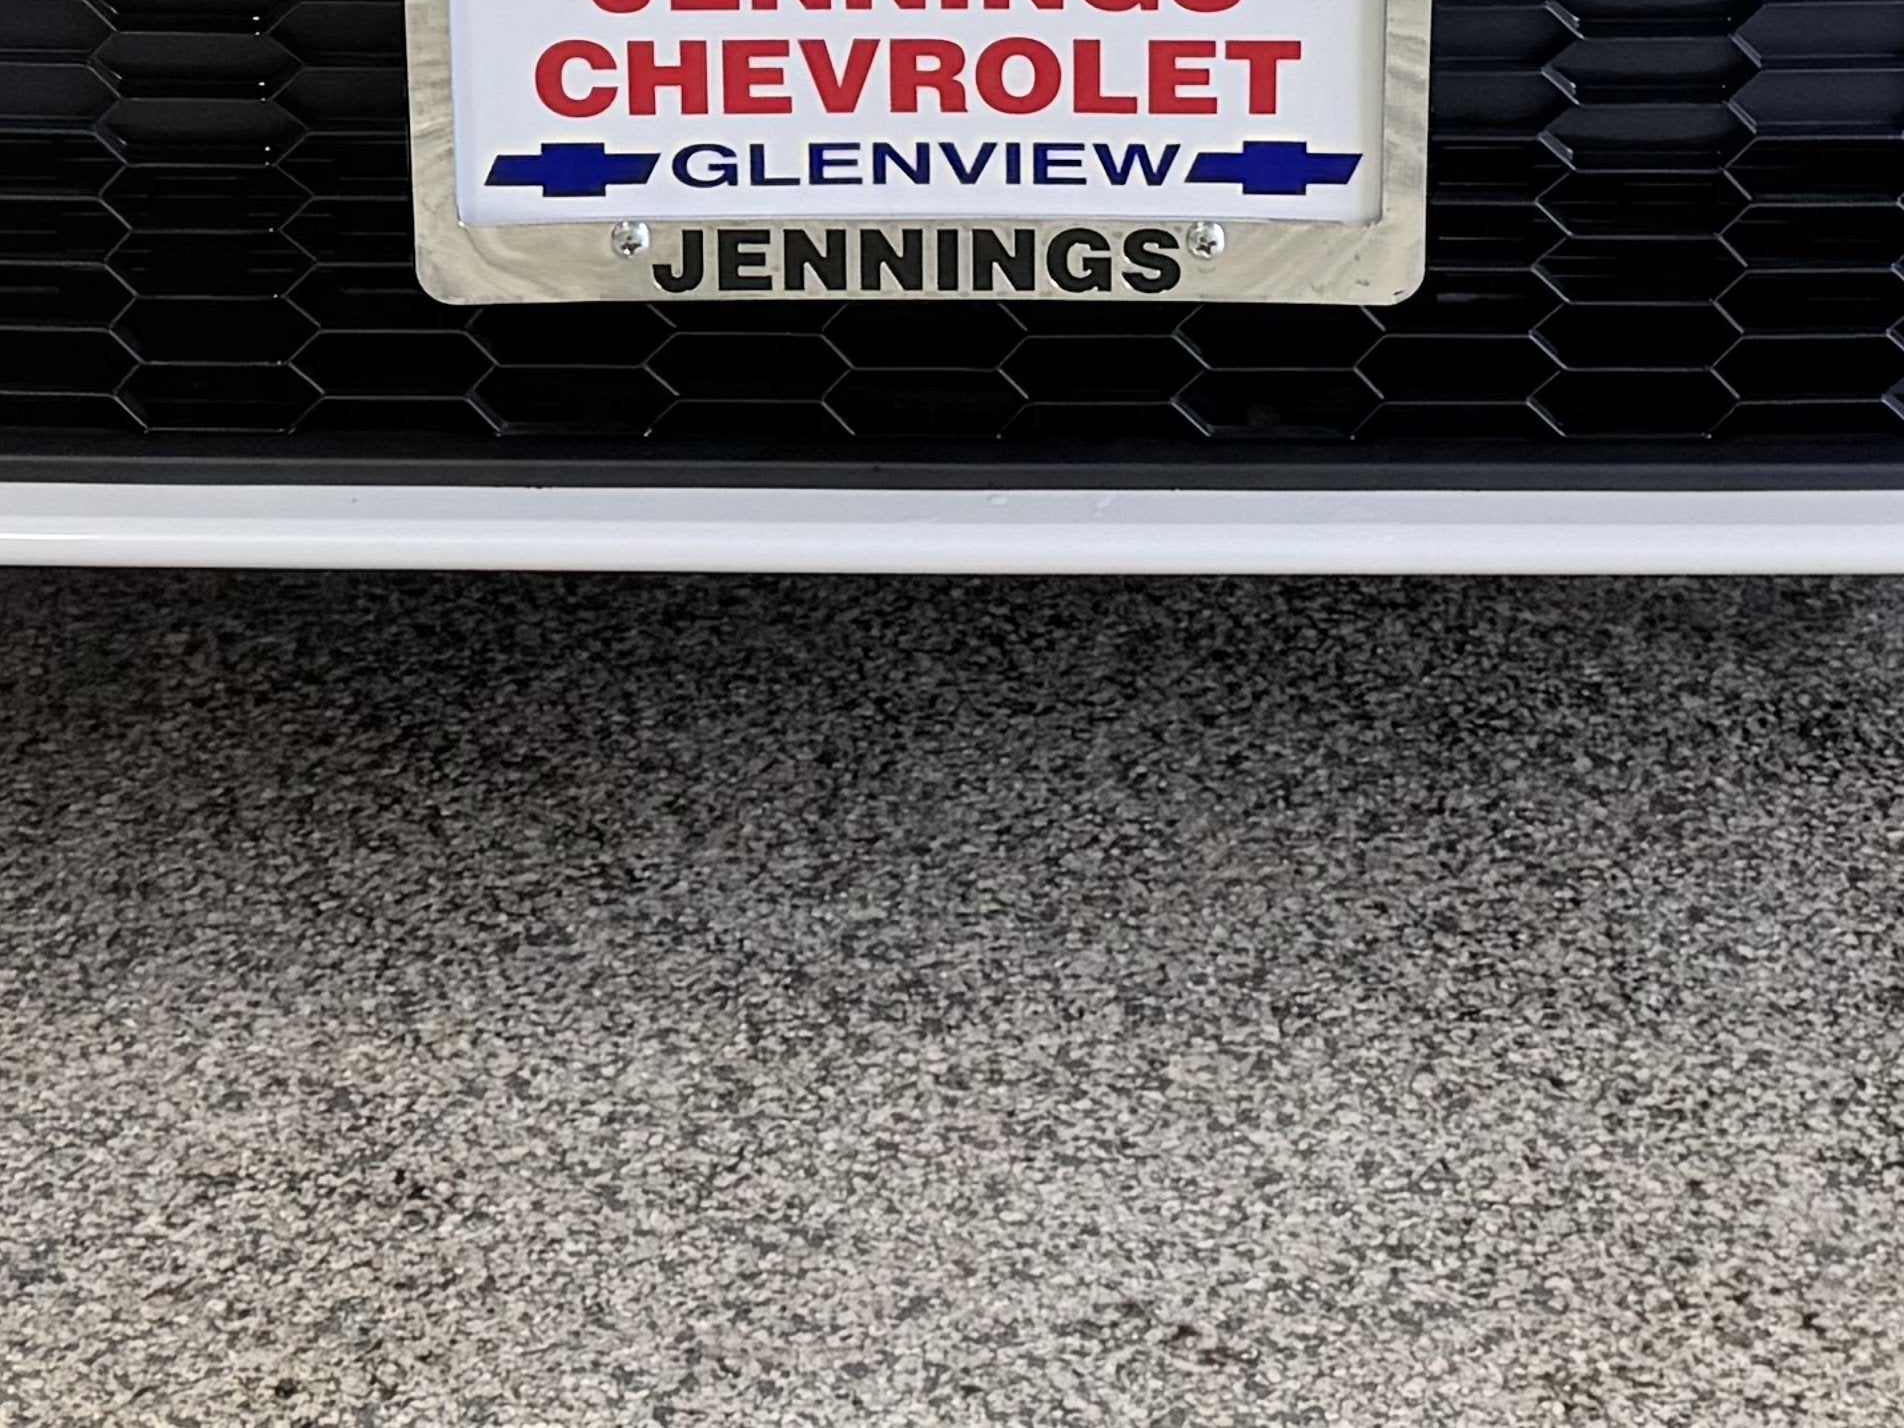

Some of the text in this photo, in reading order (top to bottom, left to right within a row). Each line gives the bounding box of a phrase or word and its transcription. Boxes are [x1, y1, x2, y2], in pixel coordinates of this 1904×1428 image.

[533, 37, 1304, 119] CHEVROLET
[670, 141, 1183, 189] GLENVIEW
[650, 227, 1183, 295] JENNINGS
